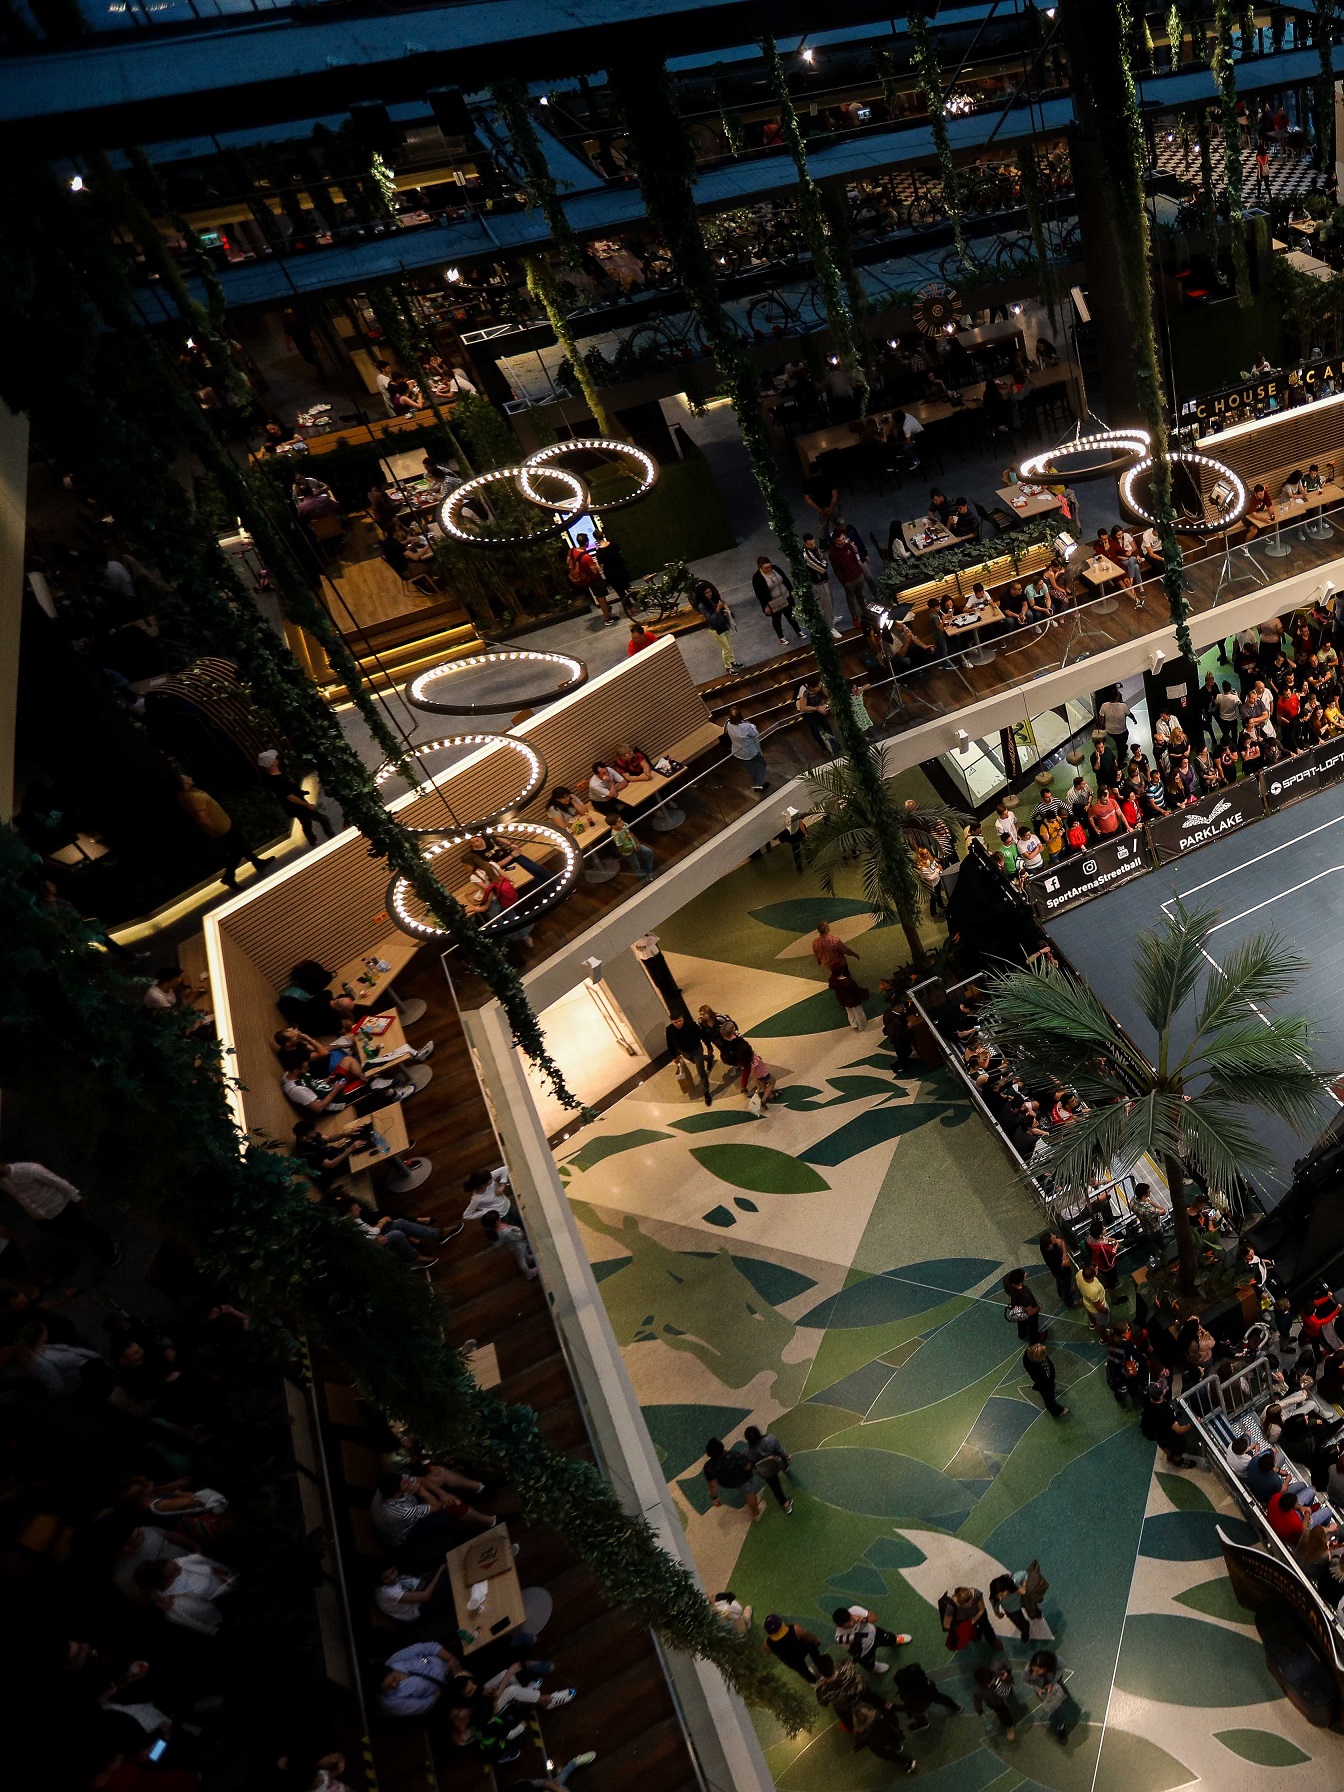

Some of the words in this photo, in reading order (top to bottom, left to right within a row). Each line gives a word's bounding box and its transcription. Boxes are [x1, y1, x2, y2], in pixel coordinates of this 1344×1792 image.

[1197, 405, 1207, 418] C
[1215, 383, 1277, 413] HOUSE
[1179, 812, 1243, 850] PARKLAKE
[1046, 857, 1141, 909] SportArenaStreetball
